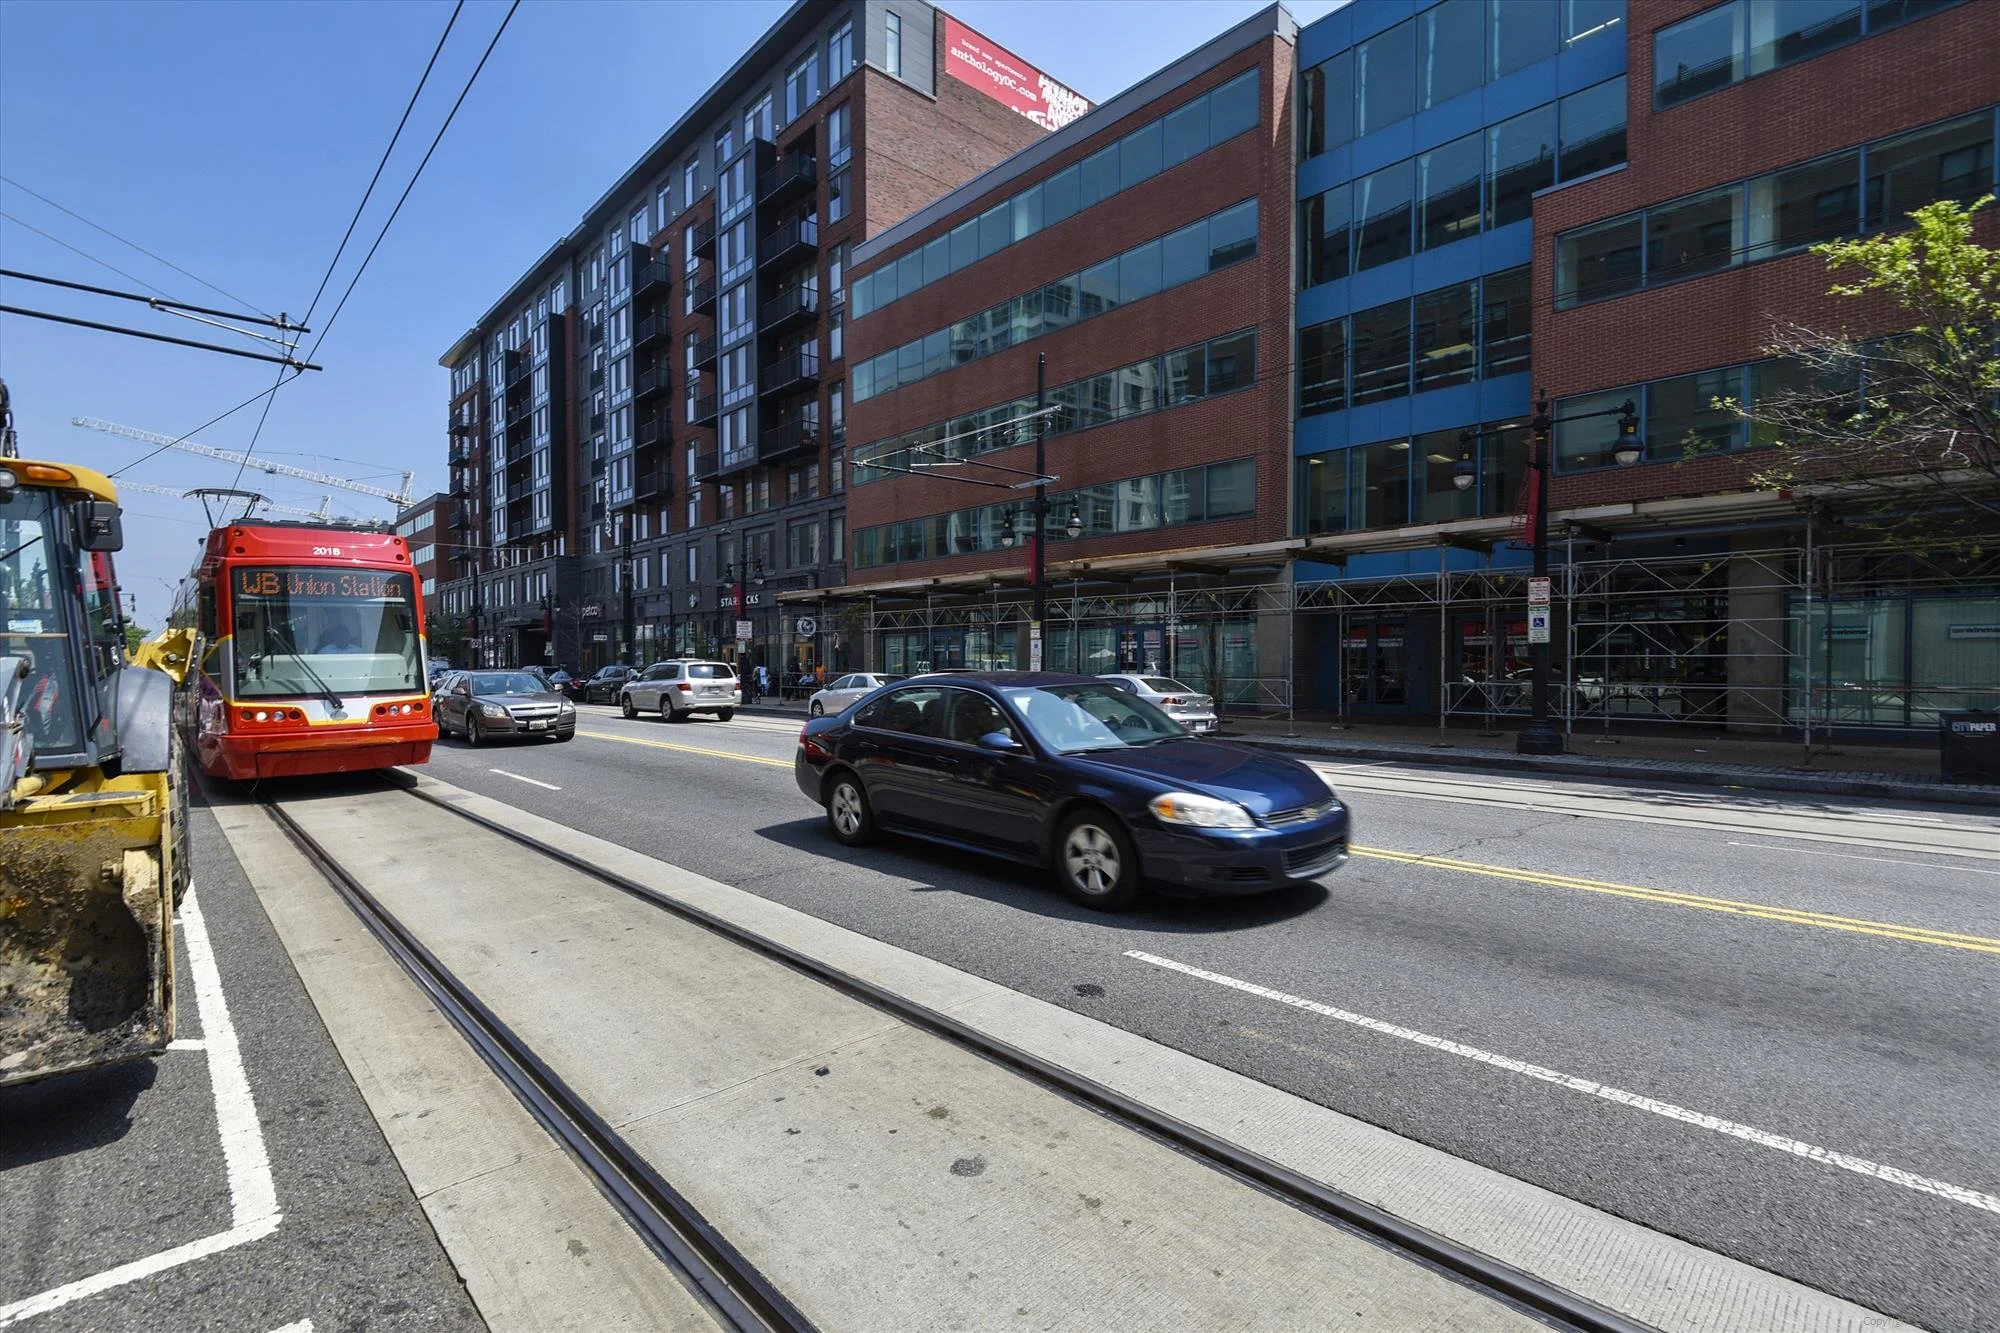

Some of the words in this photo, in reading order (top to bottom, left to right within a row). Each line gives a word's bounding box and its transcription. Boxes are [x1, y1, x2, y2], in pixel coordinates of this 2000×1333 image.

[951, 46, 1038, 102] anthologyDC.com
[242, 571, 281, 595] WB
[286, 572, 336, 595] Union
[340, 575, 402, 597] Station
[720, 594, 760, 607] STARCKS
